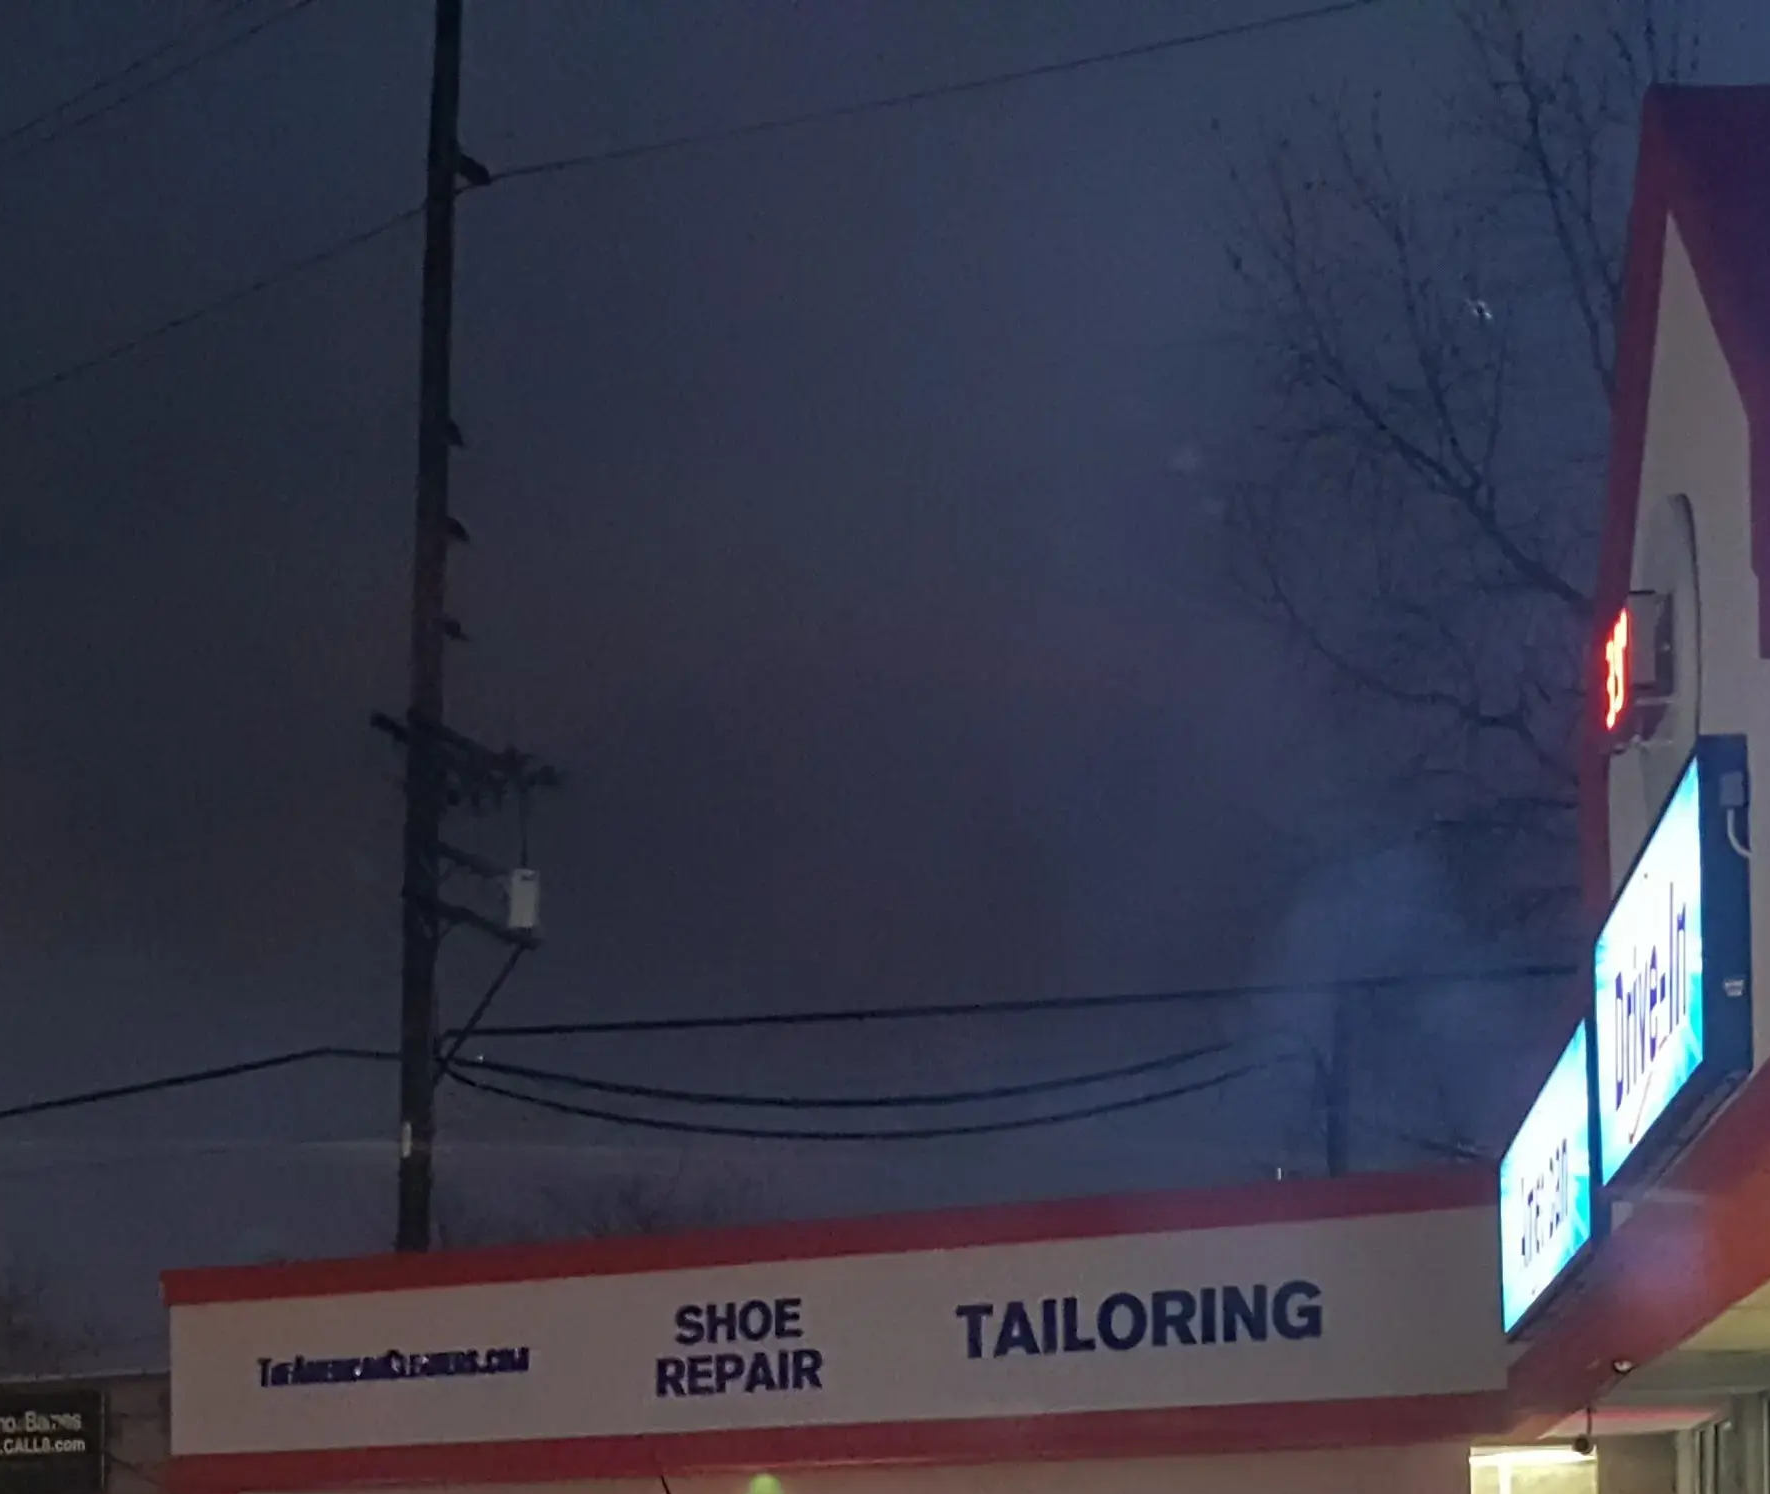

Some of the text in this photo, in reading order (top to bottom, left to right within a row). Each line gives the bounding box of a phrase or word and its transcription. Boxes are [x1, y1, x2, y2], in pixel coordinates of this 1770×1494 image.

[1615, 881, 1686, 1112] Drive-In
[675, 1298, 802, 1346] SHOE
[956, 1281, 1323, 1359] TAILORING
[655, 1346, 823, 1398] REPAIR
